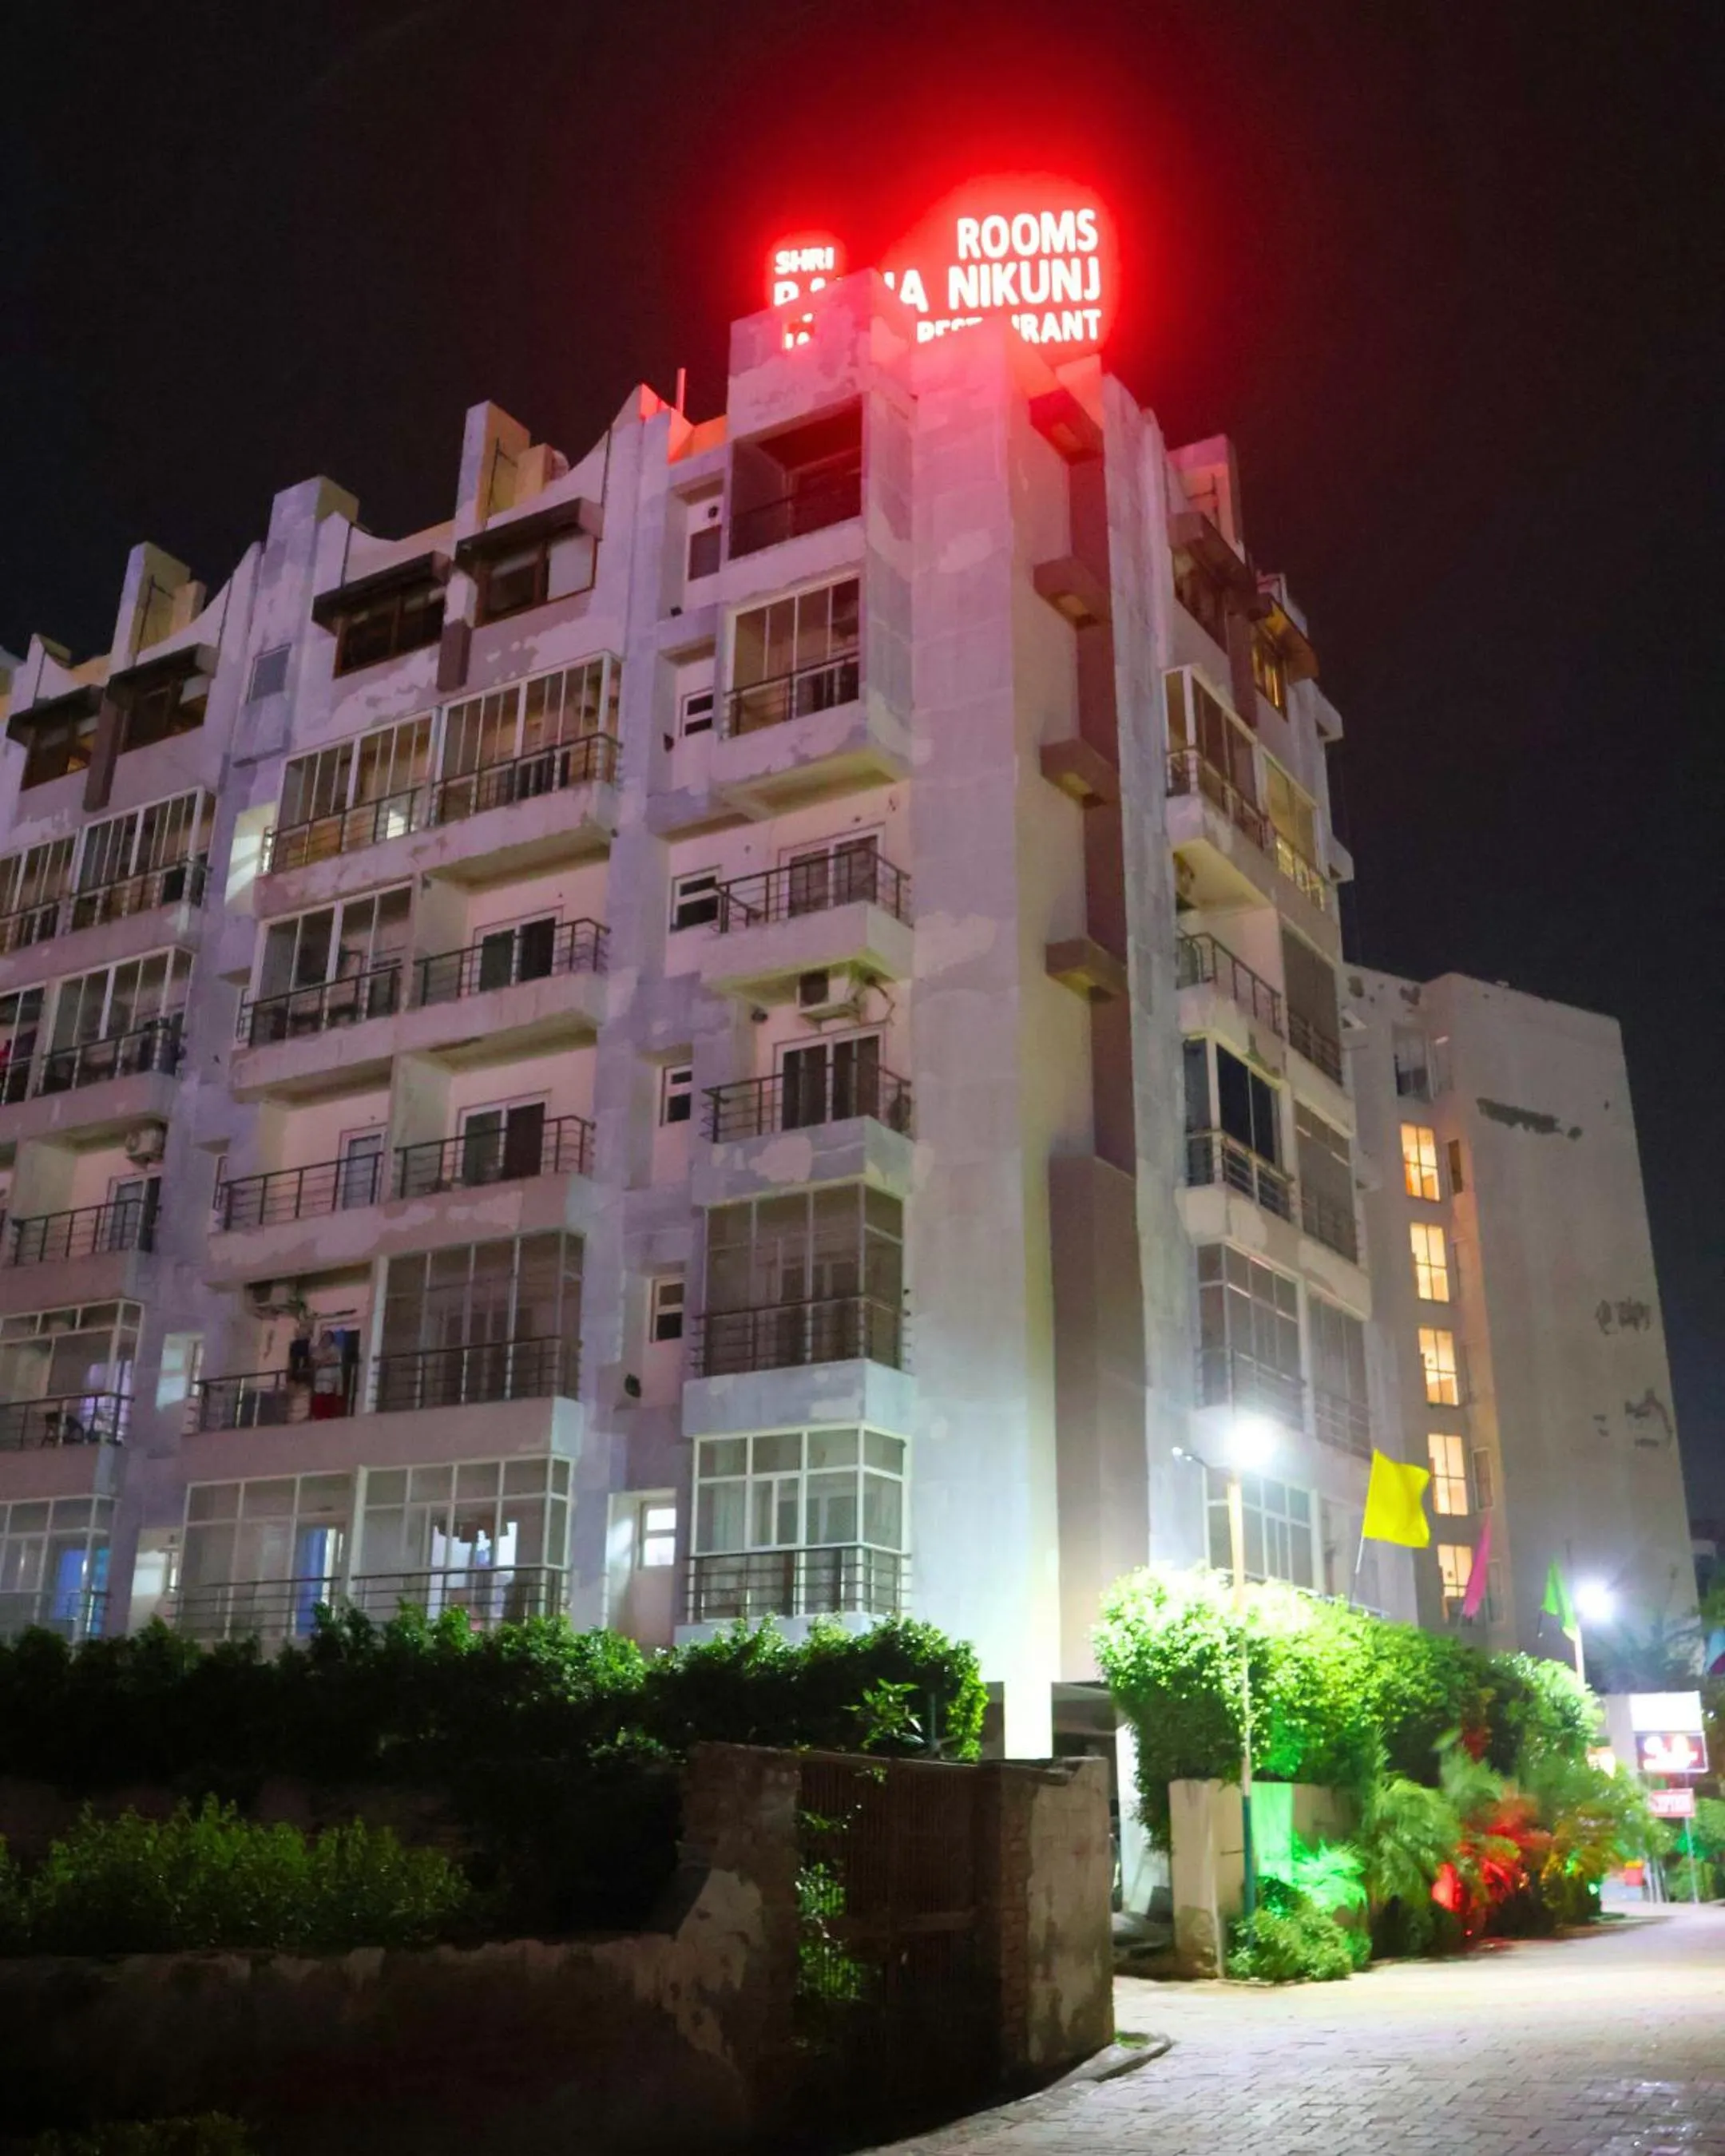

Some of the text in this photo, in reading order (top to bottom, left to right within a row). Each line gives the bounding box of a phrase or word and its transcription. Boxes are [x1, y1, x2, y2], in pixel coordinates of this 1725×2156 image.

[957, 208, 1098, 260] ROOMS
[774, 246, 835, 275] SHRI
[948, 256, 1101, 310] NIKUNJ
